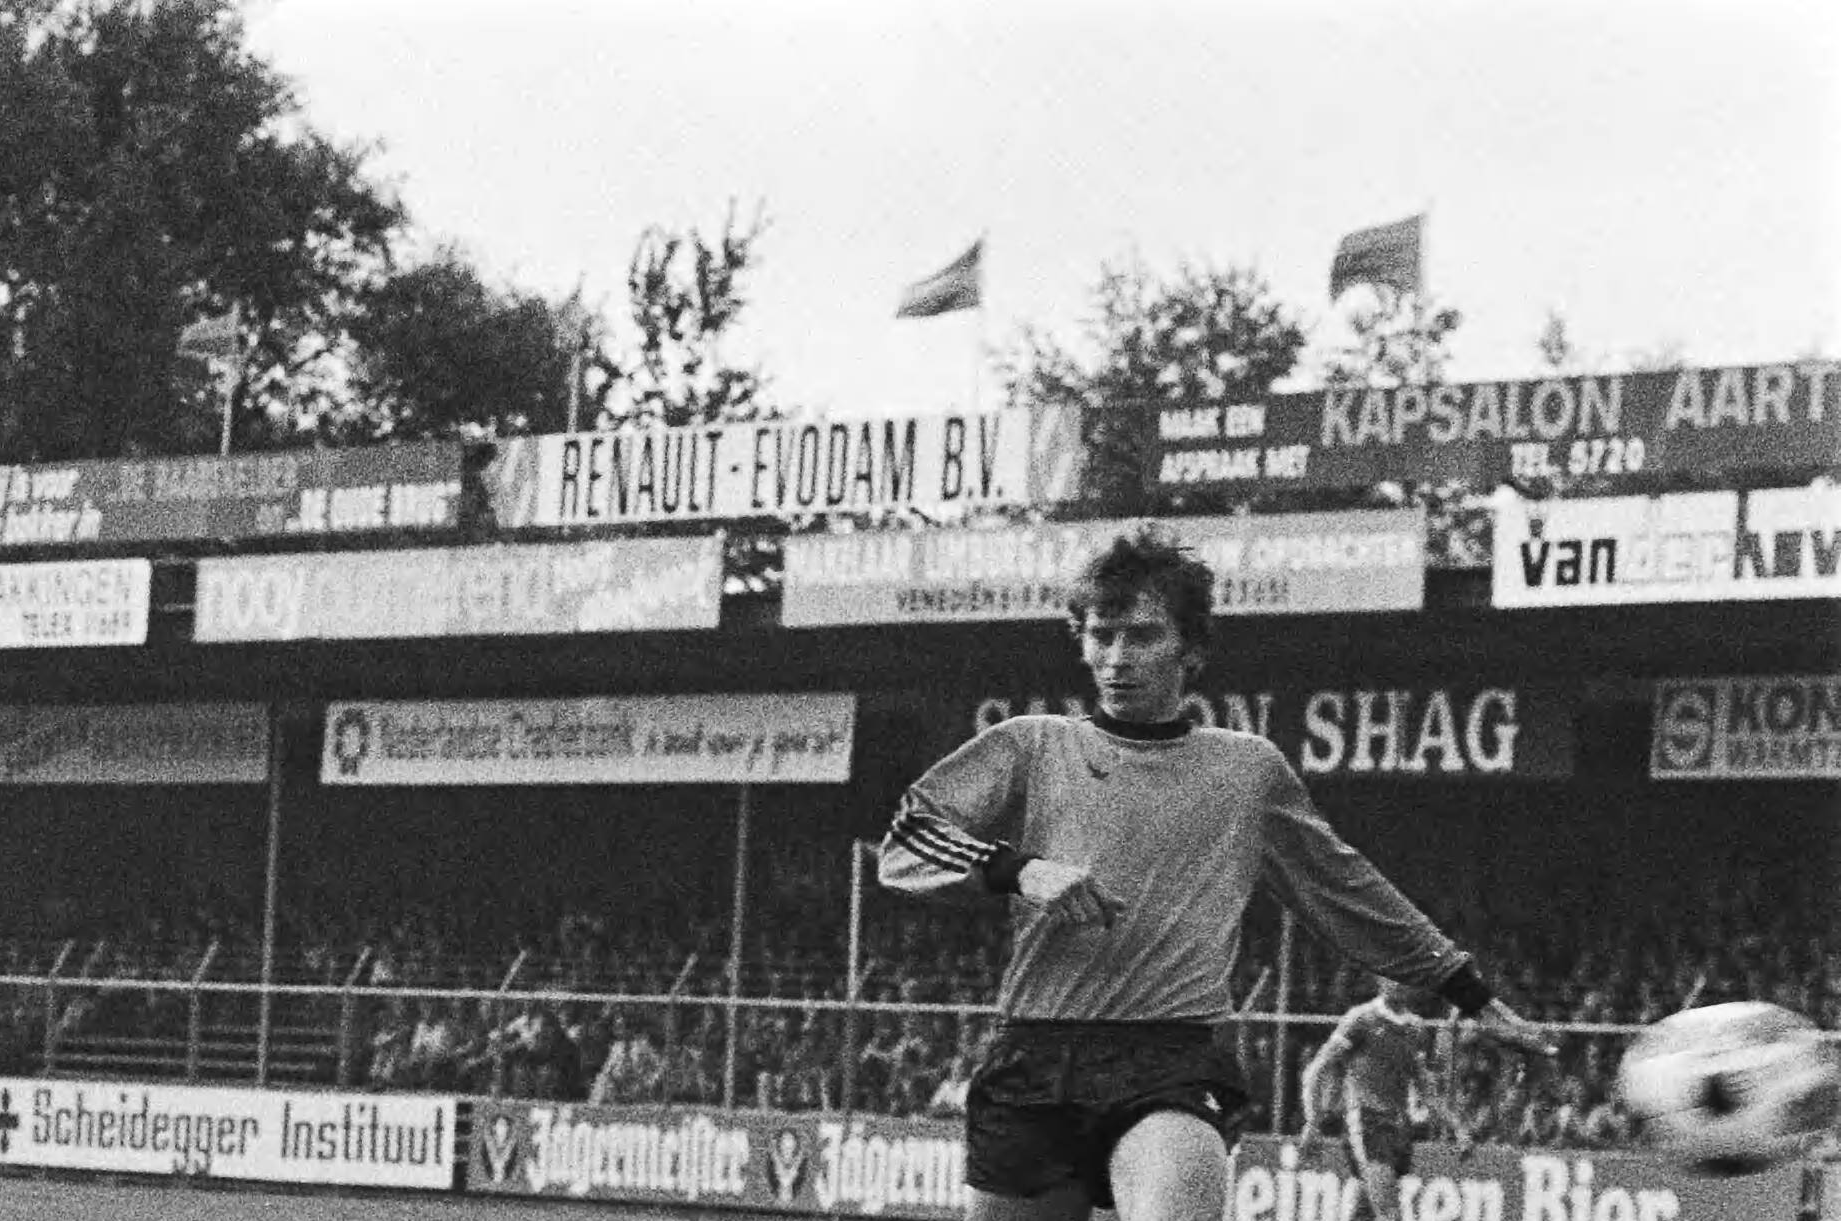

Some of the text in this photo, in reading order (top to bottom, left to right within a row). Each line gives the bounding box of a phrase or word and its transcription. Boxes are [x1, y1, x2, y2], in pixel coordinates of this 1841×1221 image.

[1320, 362, 1841, 447] KAPSALON AART
[940, 413, 1005, 501] B.V.
[1568, 437, 1646, 475] 5720
[1520, 537, 1618, 588] van
[1300, 687, 1520, 775] SHAG
[31, 1087, 446, 1176] Scheidegger Instituut
